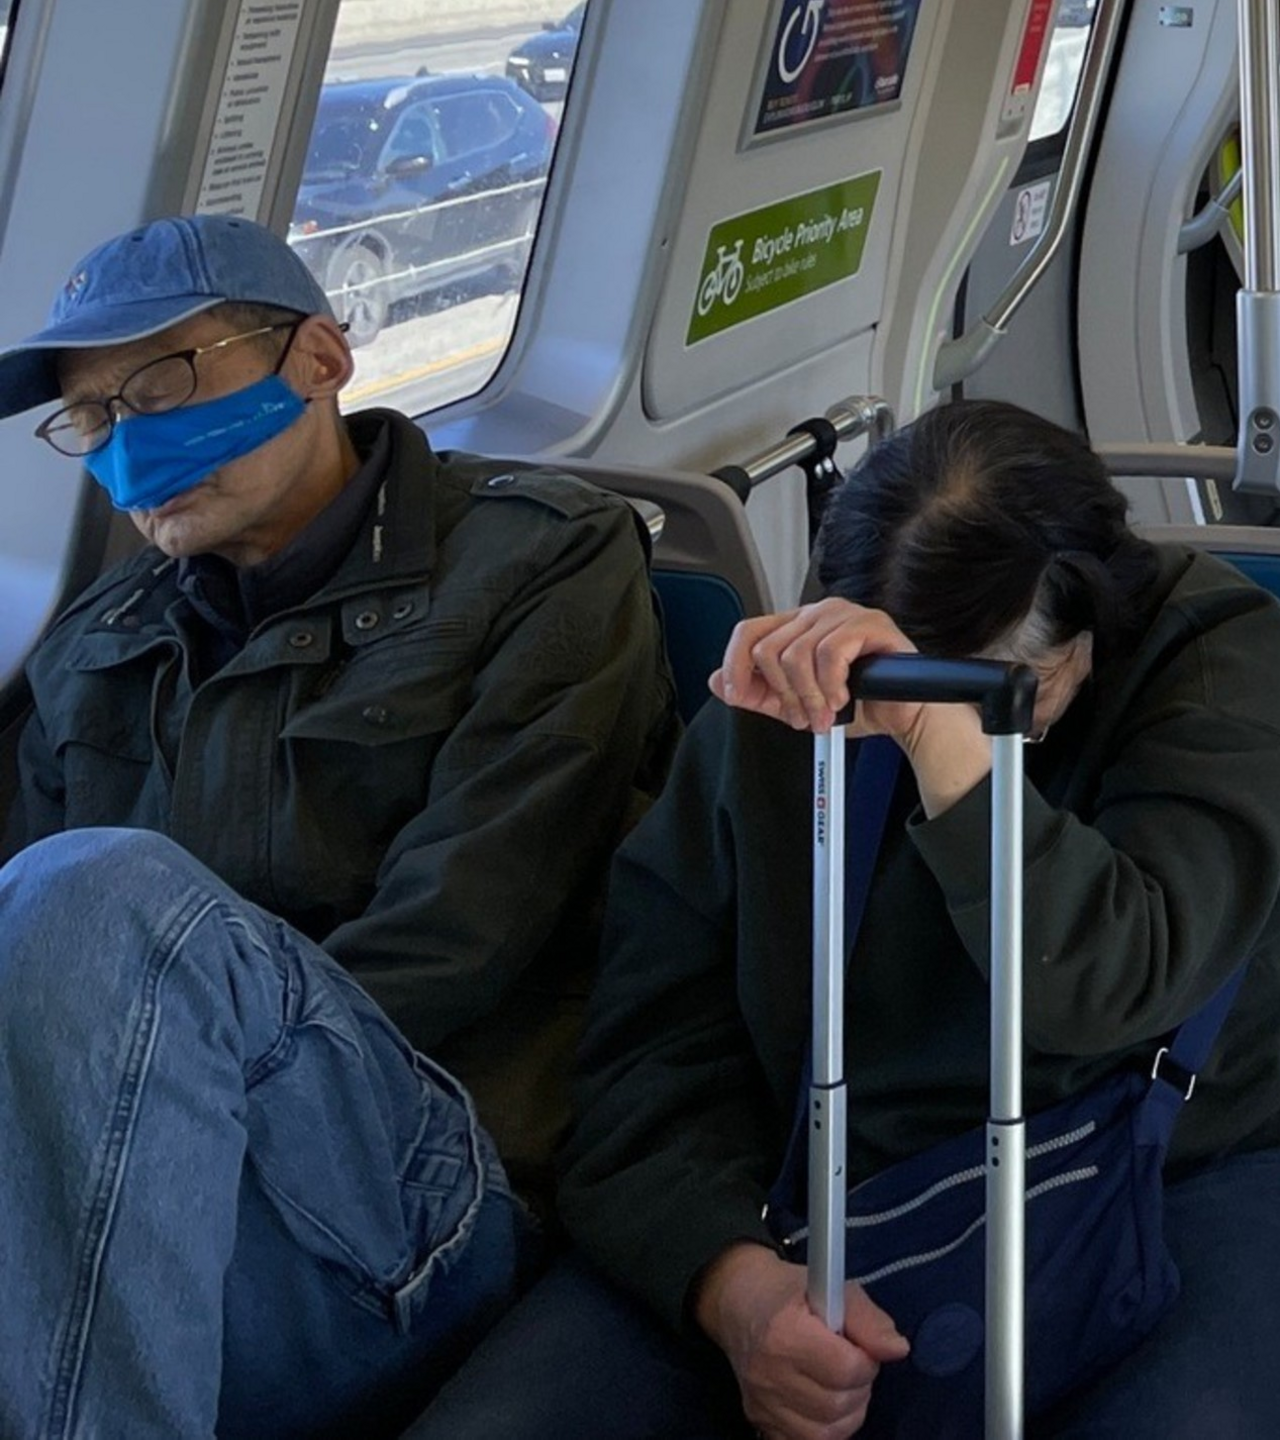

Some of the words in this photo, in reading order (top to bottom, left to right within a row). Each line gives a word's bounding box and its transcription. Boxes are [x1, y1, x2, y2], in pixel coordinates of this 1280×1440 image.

[751, 226, 794, 265] Bicycle
[794, 214, 838, 248] Priority
[837, 207, 864, 233] Area
[817, 761, 826, 794] SWISS
[817, 811, 826, 843] GEAR
